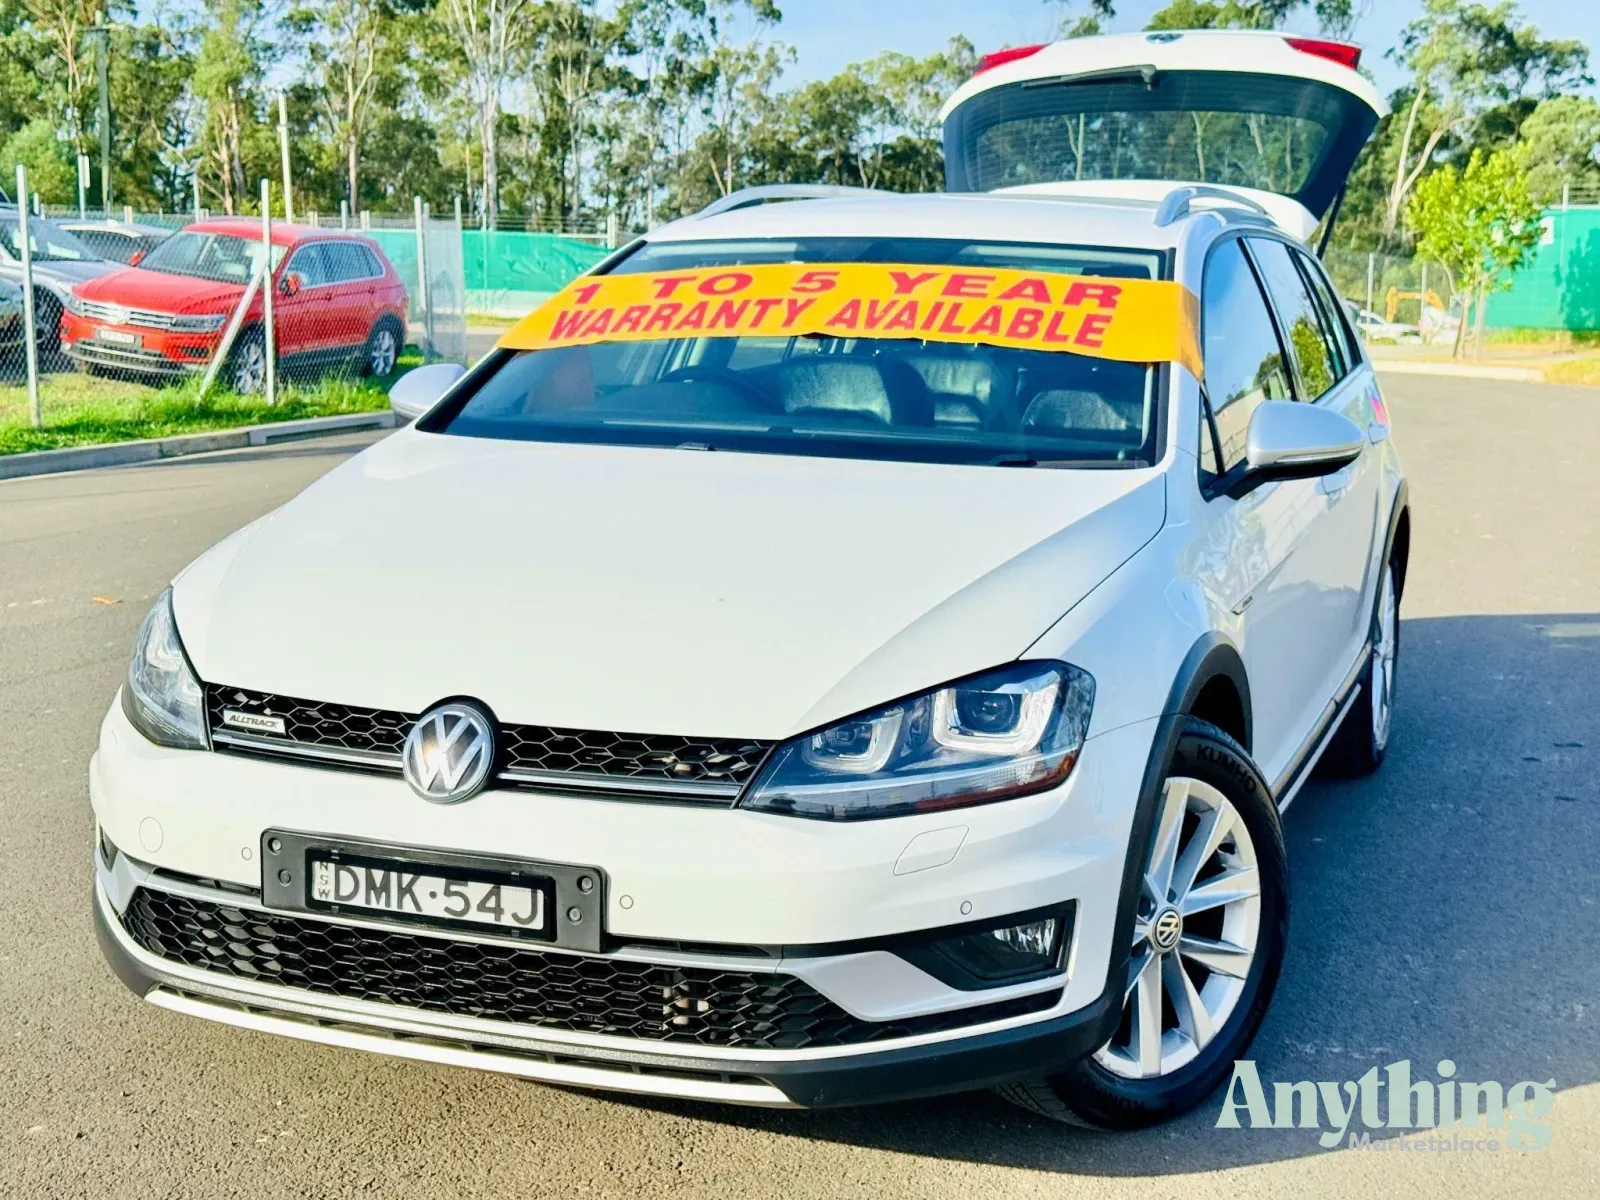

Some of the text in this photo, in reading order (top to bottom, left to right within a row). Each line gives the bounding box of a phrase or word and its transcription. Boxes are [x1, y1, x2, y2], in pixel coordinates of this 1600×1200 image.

[574, 271, 1123, 309] 1 TO 5 YEAR
[549, 298, 1113, 348] WARRANTY AVAILABLE
[228, 713, 280, 729] ALLTRACK
[1196, 743, 1257, 793] KUMHO
